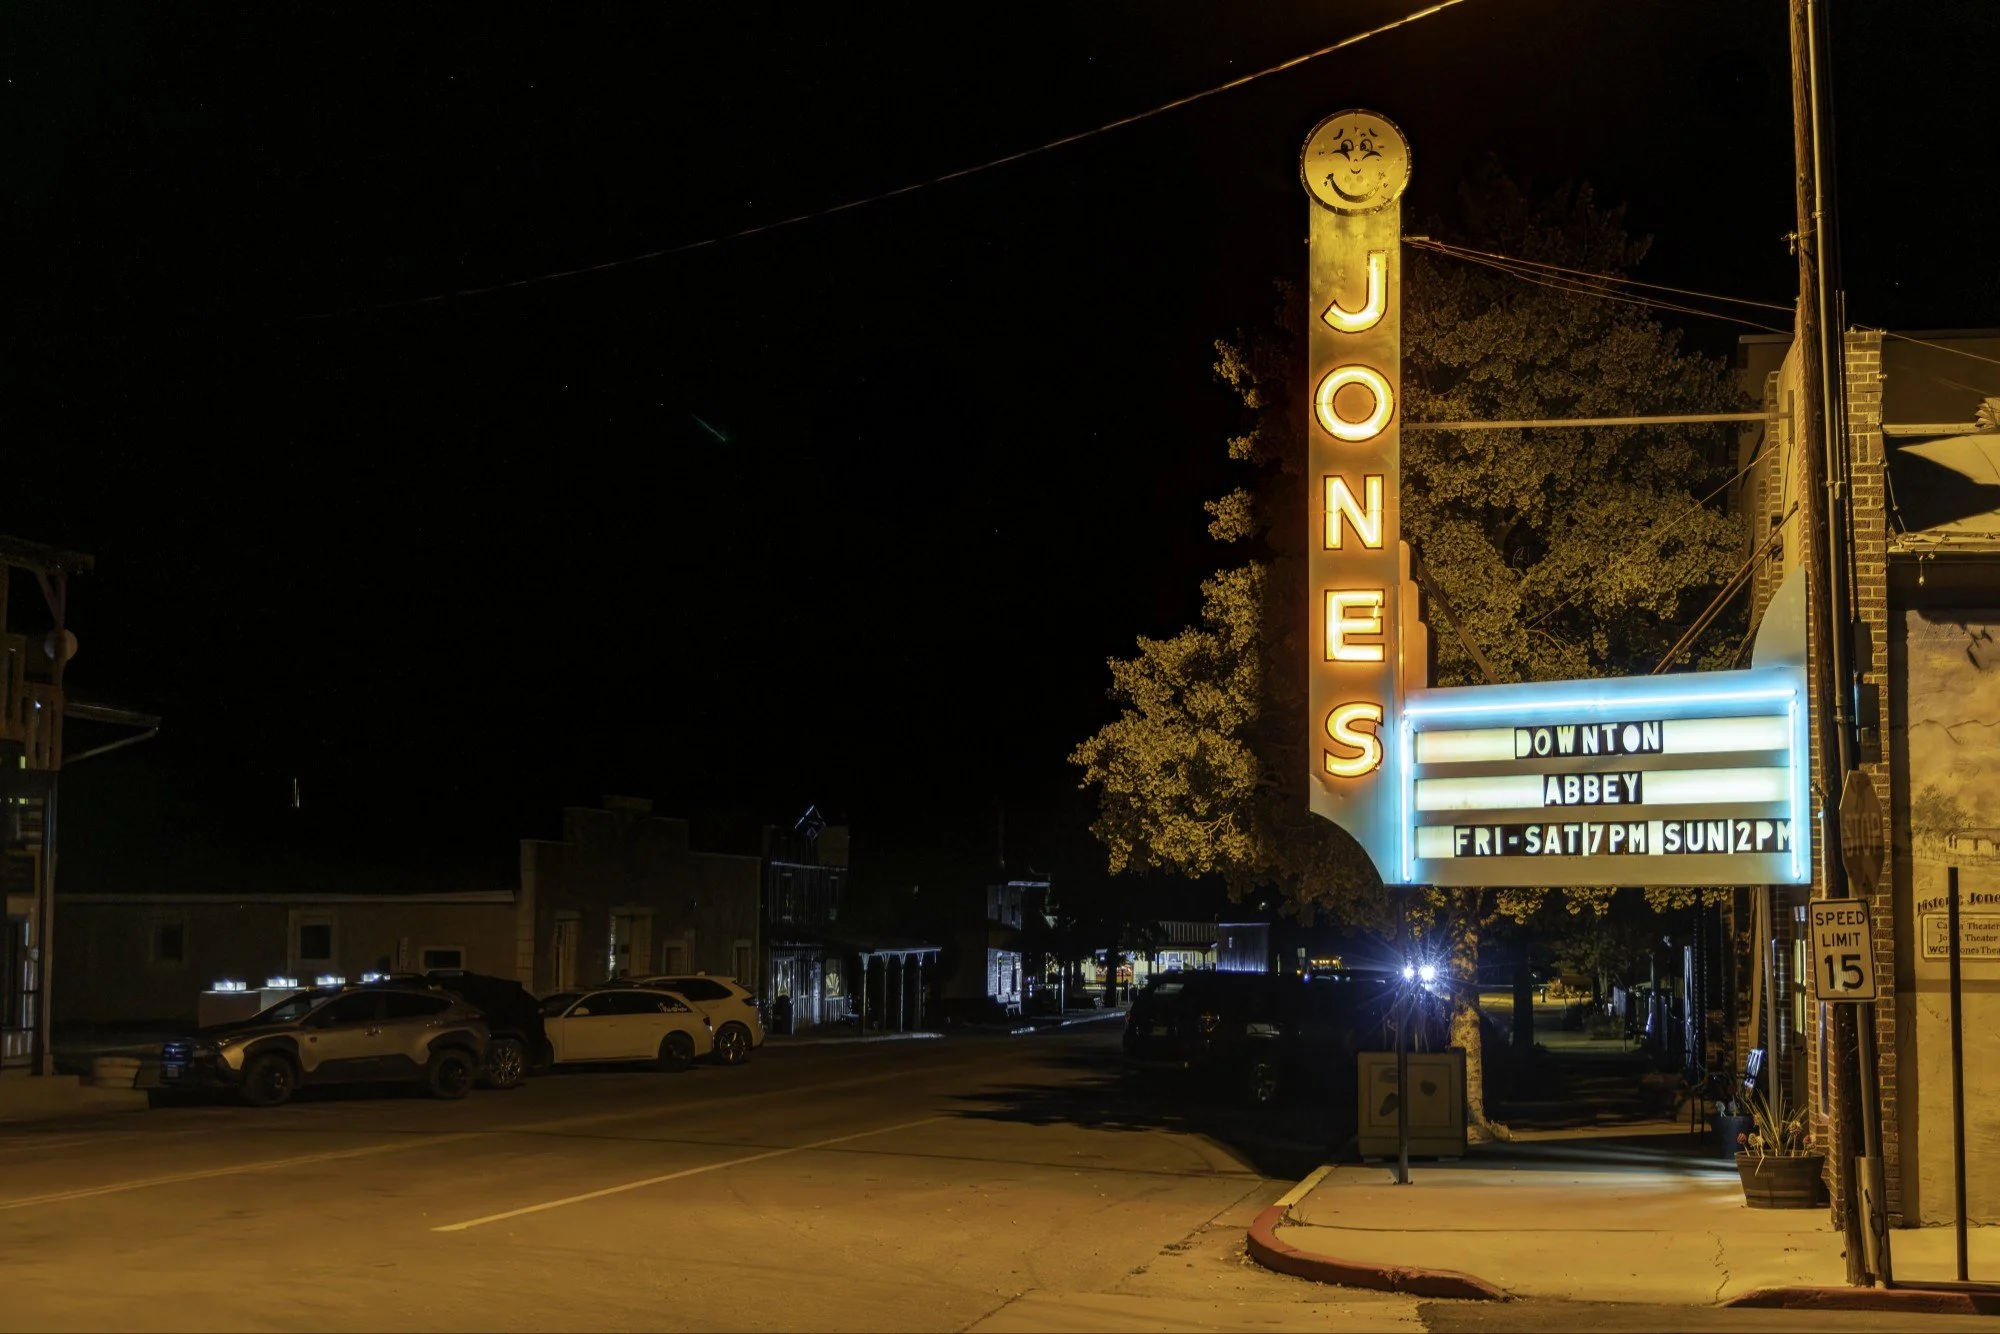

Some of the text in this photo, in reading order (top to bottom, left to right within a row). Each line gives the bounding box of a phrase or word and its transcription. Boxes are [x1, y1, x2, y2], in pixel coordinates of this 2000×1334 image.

[1313, 249, 1396, 778] JONES
[1515, 720, 1660, 758] DOWNTON
[1544, 772, 1638, 805] ABBEY
[1455, 821, 1793, 856] FRI-SAT 7PM SUN 2PM
[1815, 910, 1865, 926] SPEED
[1917, 894, 1964, 916] Historc
[1822, 932, 1861, 948] LIMIT
[1965, 933, 1998, 942] Theater
[1824, 953, 1865, 990] 15
